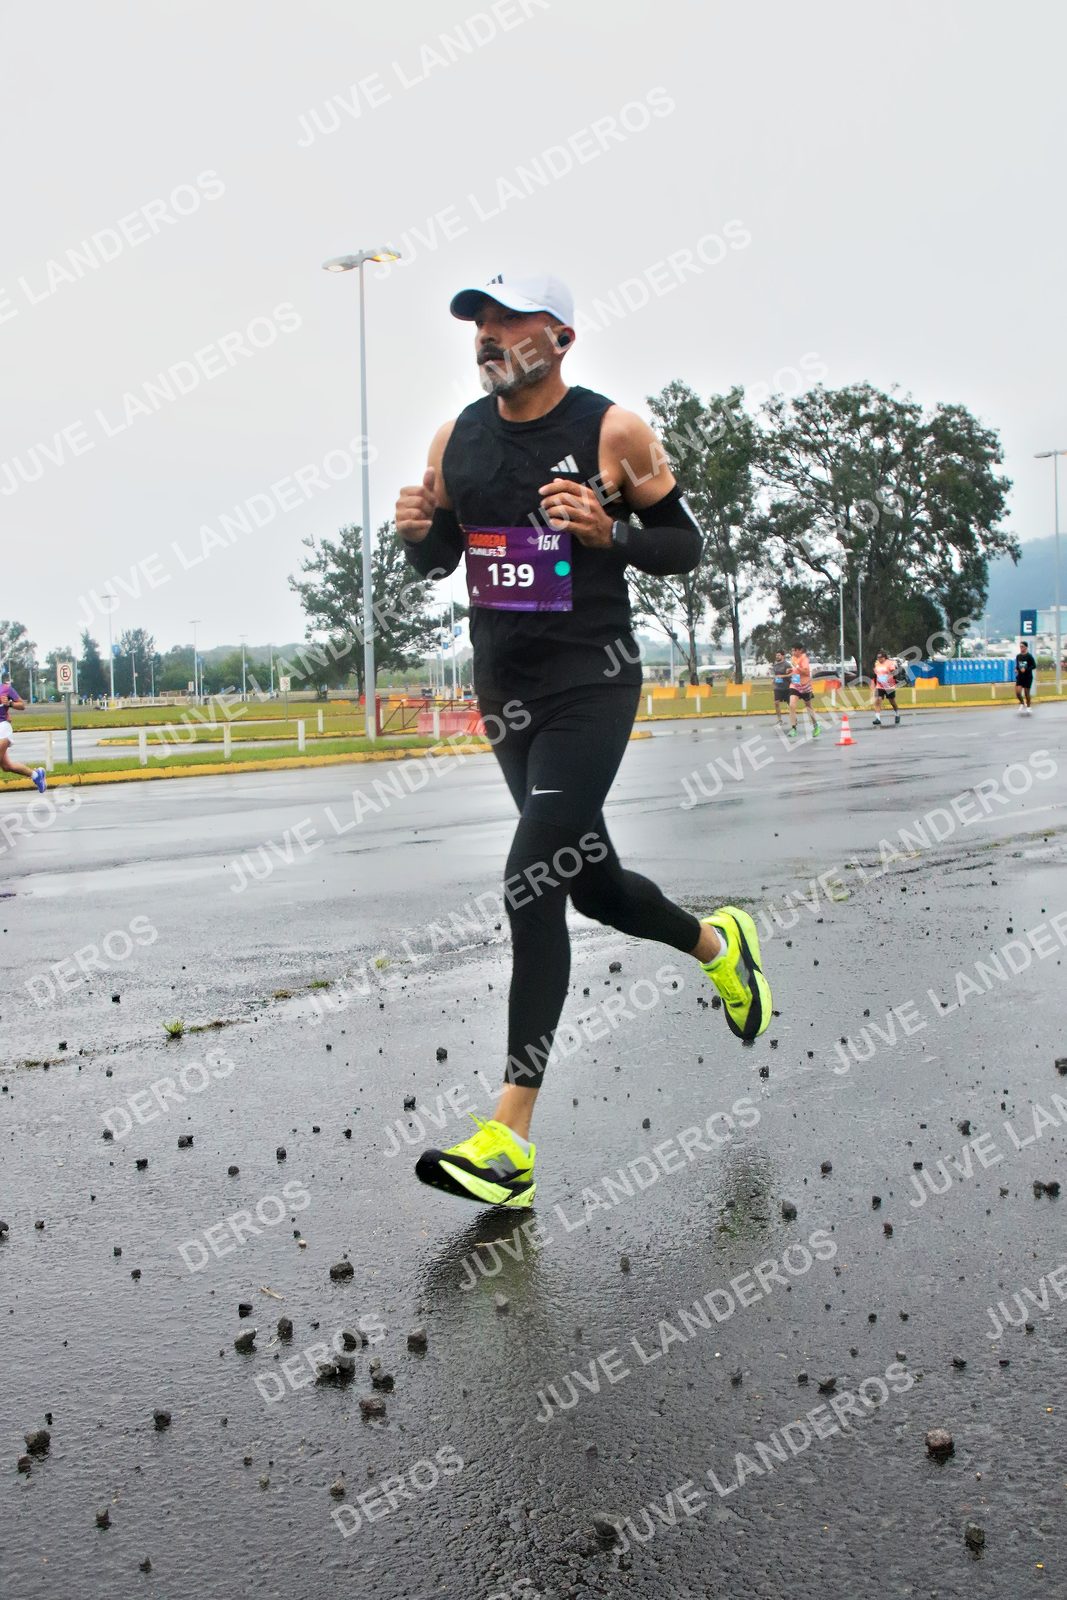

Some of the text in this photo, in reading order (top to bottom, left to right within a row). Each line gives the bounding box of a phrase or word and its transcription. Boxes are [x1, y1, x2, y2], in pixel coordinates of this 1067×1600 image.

[537, 535, 561, 551] 15K
[487, 563, 535, 588] 139
[1023, 621, 1033, 633] E
